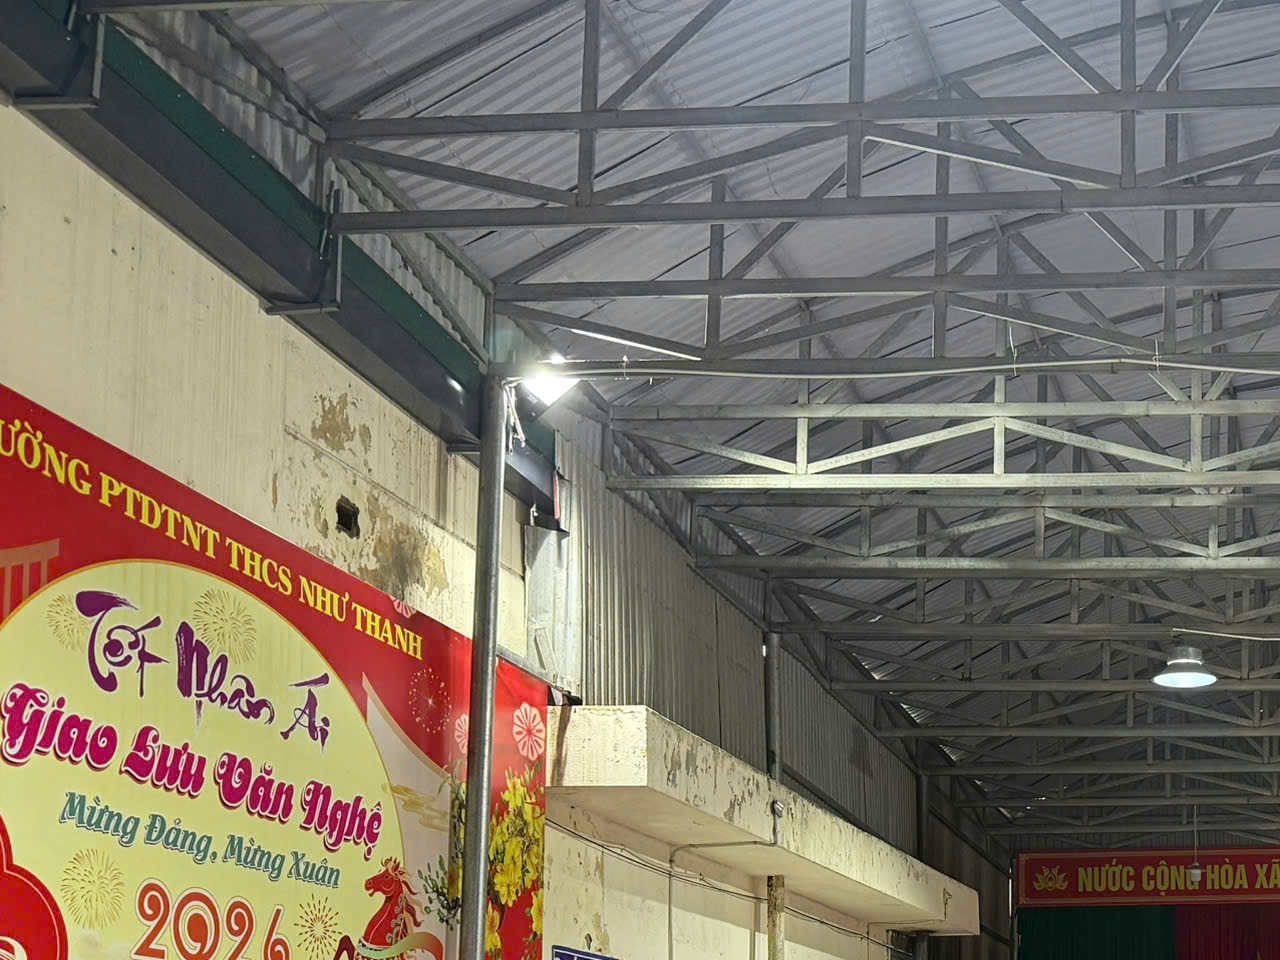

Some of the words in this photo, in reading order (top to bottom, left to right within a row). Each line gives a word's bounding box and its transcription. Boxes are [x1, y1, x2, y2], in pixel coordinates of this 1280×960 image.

[99, 471, 220, 560] PTDTNT
[225, 537, 293, 596] THCS
[298, 574, 350, 623] NHƯ
[351, 601, 423, 661] THANH
[175, 620, 275, 727] Nhân
[1, 683, 118, 769] Giao
[120, 725, 207, 798] Lưu
[213, 752, 295, 824] Văn
[299, 779, 384, 861] Nghệ
[59, 792, 140, 848] Mừng
[144, 814, 218, 865] Đảng,
[222, 834, 286, 883] Mừng
[287, 850, 341, 889] Xuân
[1077, 858, 1135, 892] NƯỚC
[1207, 857, 1249, 890] HÒA
